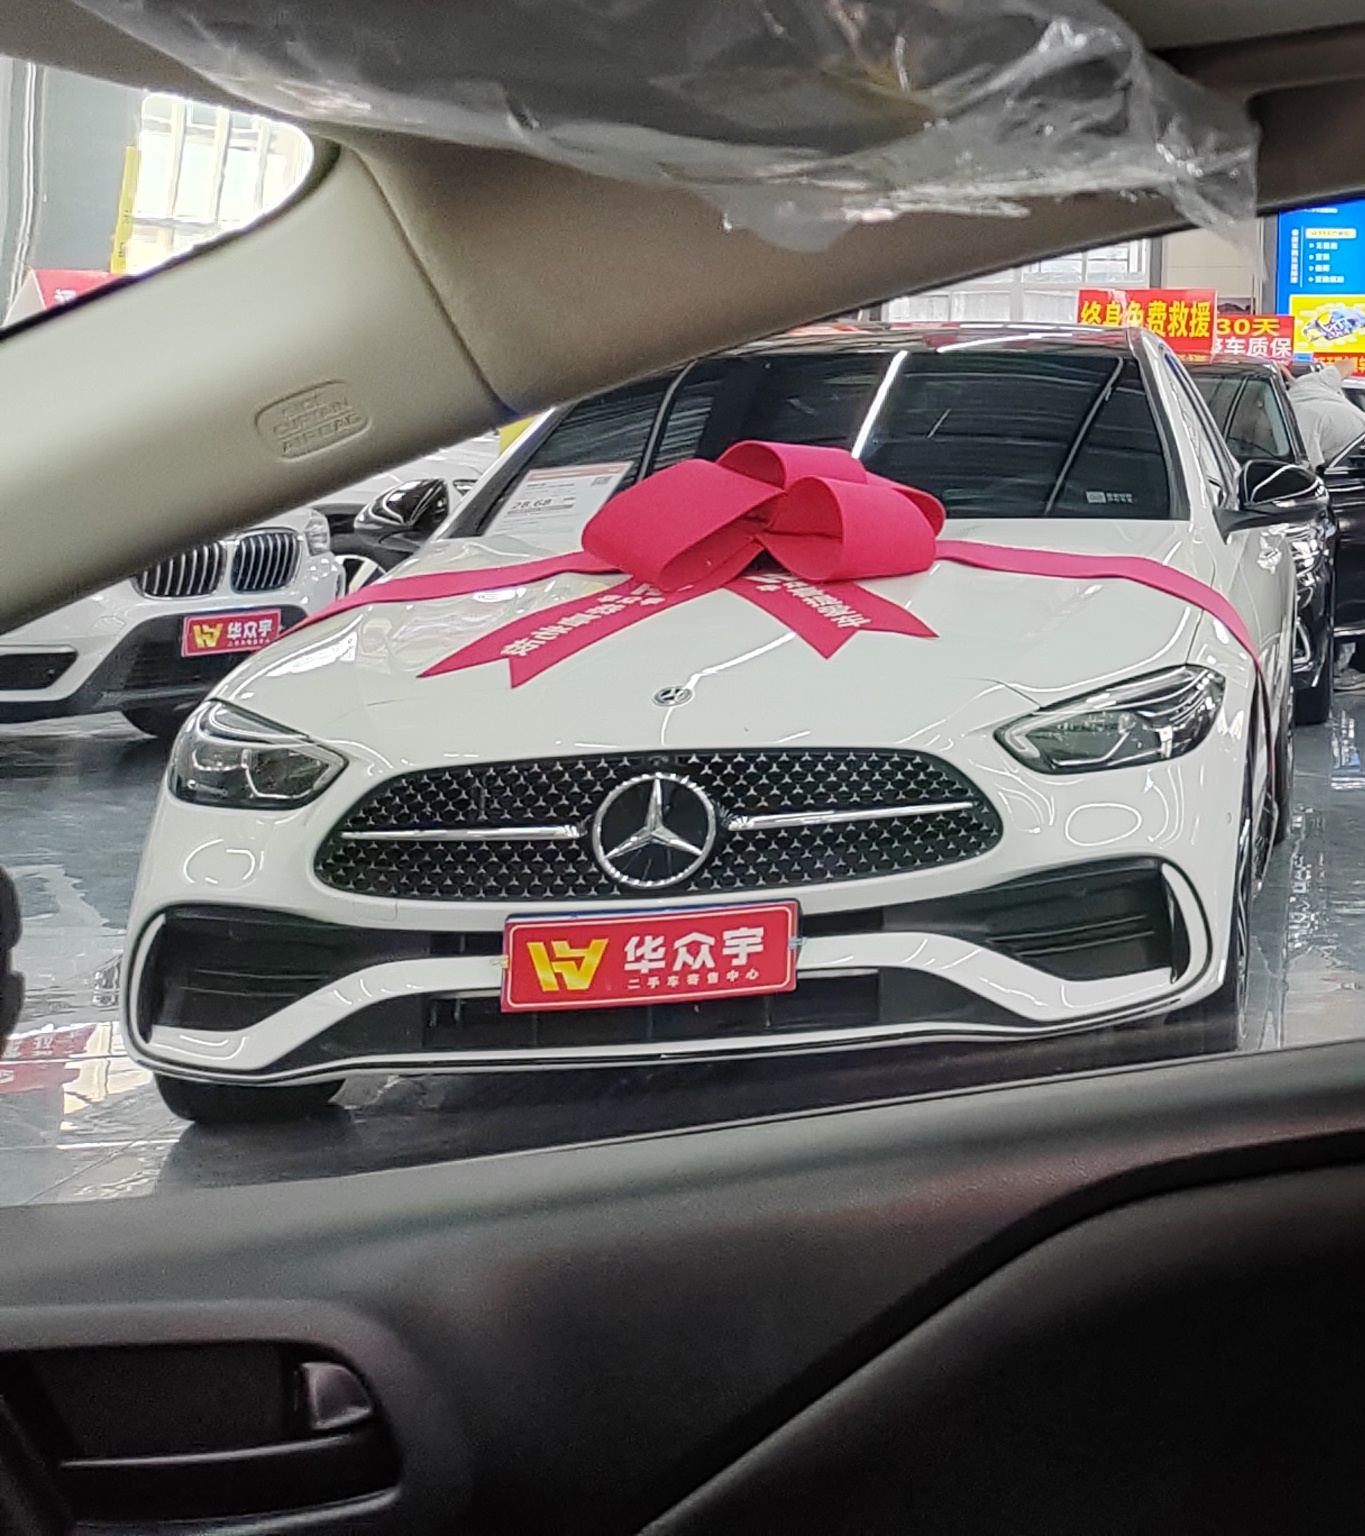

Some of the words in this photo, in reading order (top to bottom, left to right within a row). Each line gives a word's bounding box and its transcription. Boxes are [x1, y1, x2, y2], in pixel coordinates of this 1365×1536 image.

[1216, 317, 1281, 337] 30天
[227, 619, 273, 640] 华众宇
[623, 926, 764, 975] 华众宇
[627, 968, 760, 991] 二手车寄售中心
